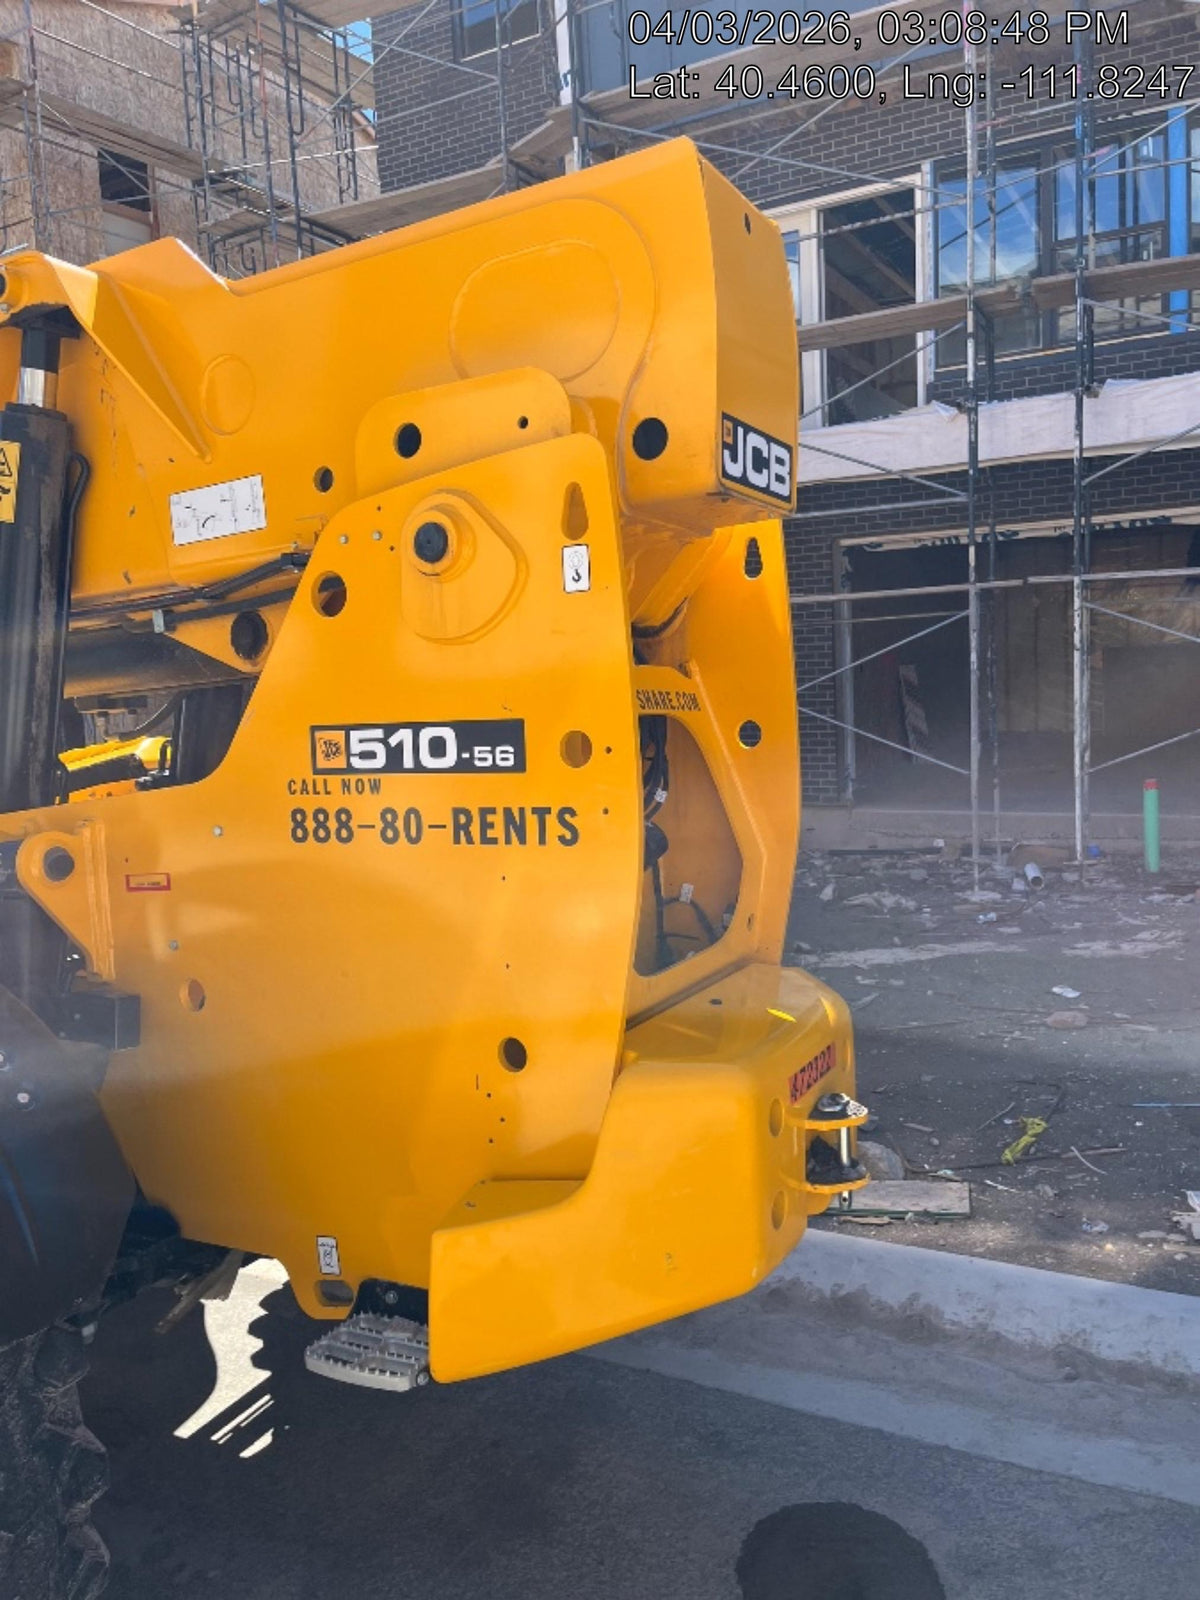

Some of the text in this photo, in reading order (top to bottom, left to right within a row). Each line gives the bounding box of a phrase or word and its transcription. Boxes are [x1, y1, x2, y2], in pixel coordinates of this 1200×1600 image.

[723, 425, 790, 497] JCB
[287, 778, 382, 796] CALL NOW
[290, 806, 580, 847] 888-80-RENTS
